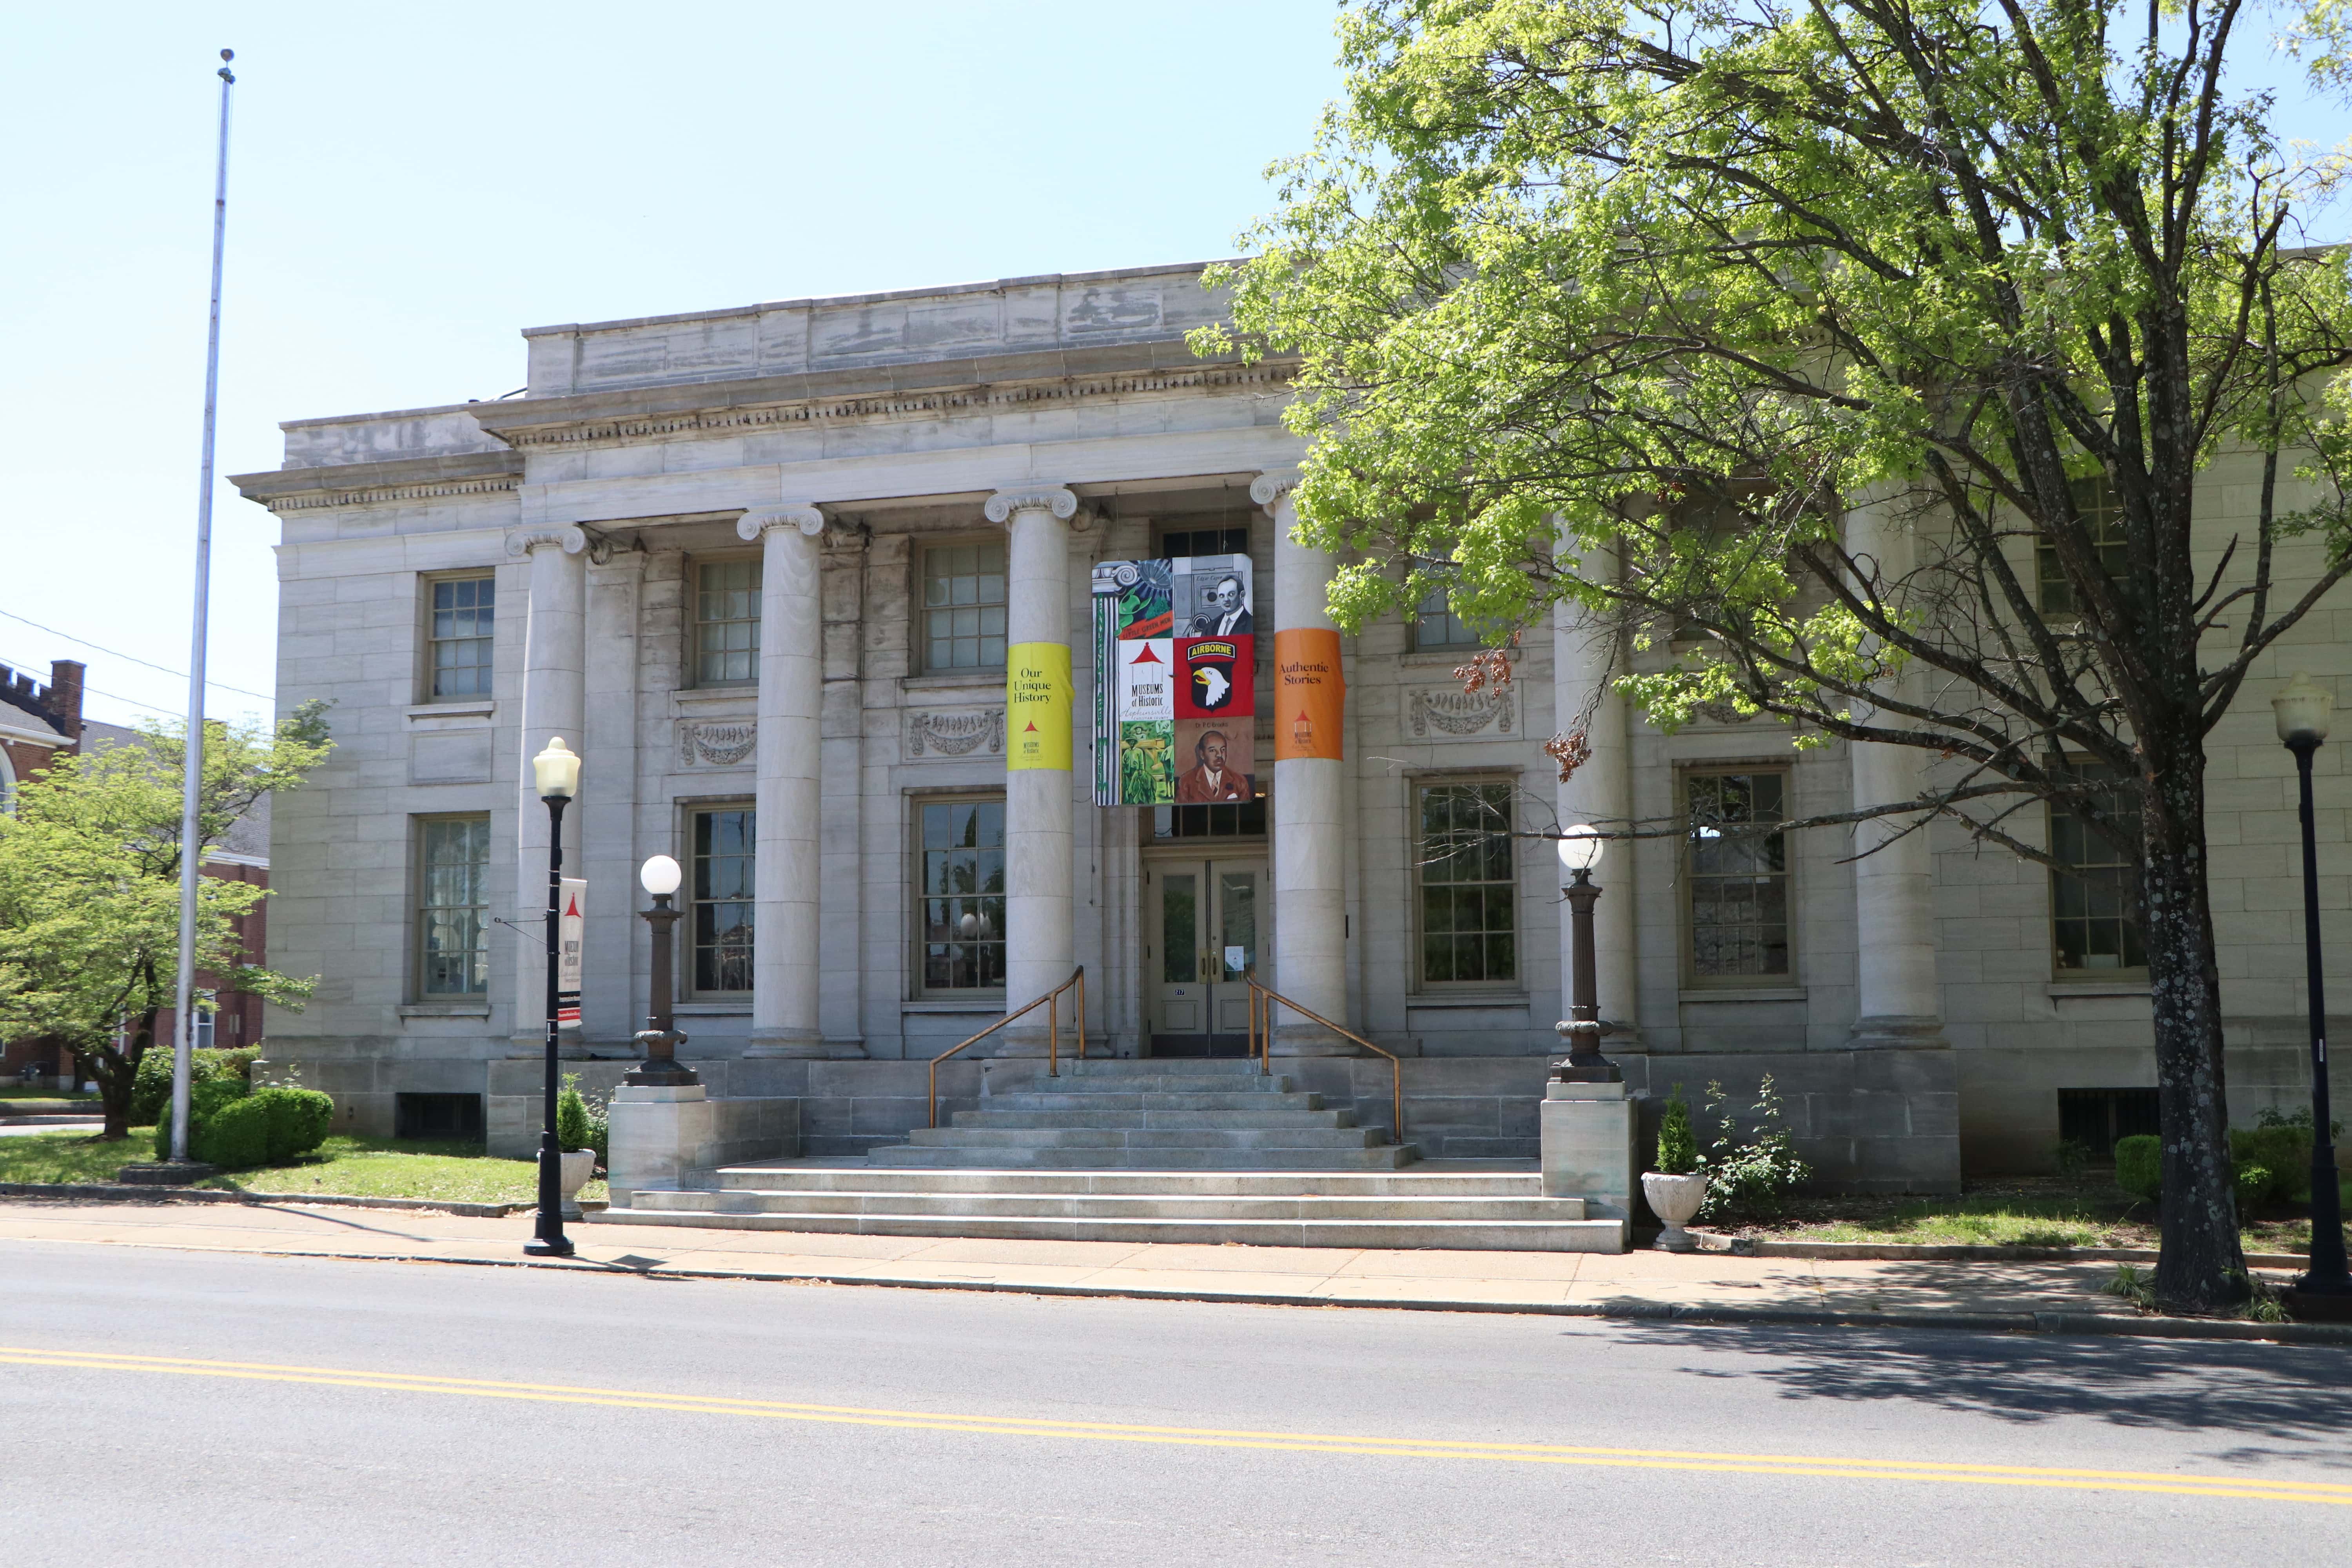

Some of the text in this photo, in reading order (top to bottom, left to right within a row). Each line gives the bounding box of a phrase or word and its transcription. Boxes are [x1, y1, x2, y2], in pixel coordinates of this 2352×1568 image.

[1142, 622, 1158, 632] GREEN
[1191, 644, 1232, 656] AIRBORNE
[1021, 668, 1042, 678] Our
[1278, 661, 1329, 674] Authentic
[1014, 679, 1051, 691] Unique
[1285, 673, 1321, 685] Stories
[1132, 683, 1163, 697] MUSEUMS
[1014, 692, 1051, 704] History
[1131, 695, 1163, 707] of Historic
[1120, 706, 1172, 720] Hopkinsville
